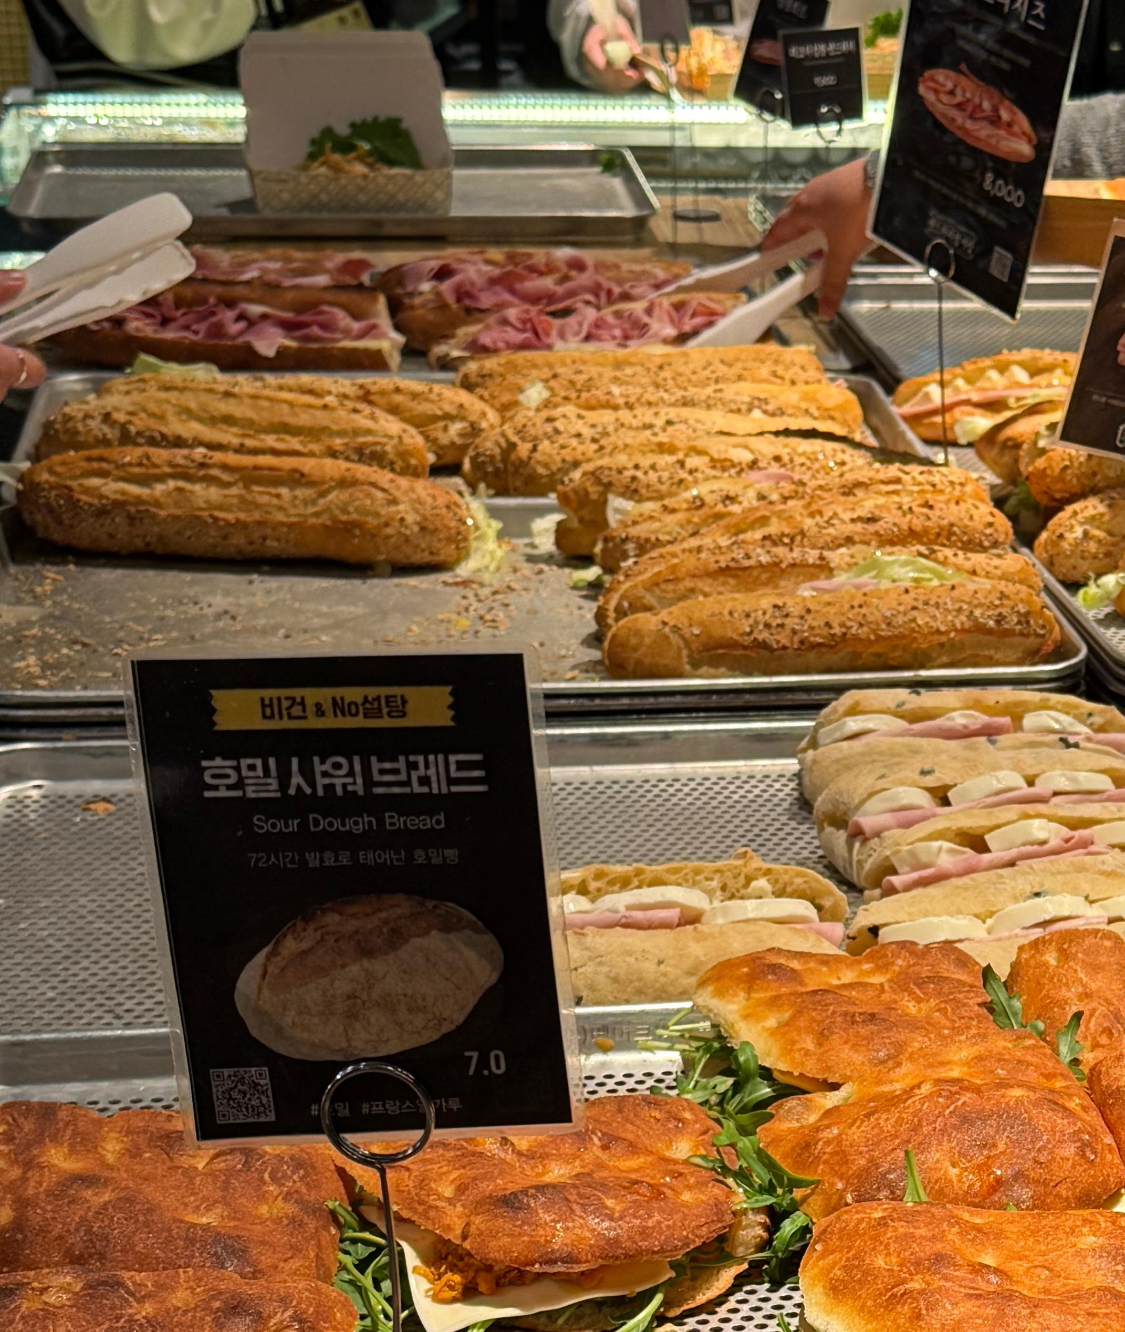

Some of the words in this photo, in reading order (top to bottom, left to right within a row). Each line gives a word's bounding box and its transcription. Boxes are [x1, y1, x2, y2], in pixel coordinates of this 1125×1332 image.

[260, 696, 308, 721] 비건
[314, 702, 326, 718] &
[331, 694, 409, 720] No설탕
[200, 755, 282, 799] 호밀
[370, 752, 489, 795] 브레드
[252, 813, 300, 834] Sour
[308, 812, 378, 836] Dough
[384, 811, 446, 831] Bread
[247, 851, 300, 869] 72시간
[304, 850, 354, 868] 발효로
[358, 849, 407, 867] 태어난
[412, 847, 460, 866] 호밀빵
[463, 1050, 507, 1076] 7.0
